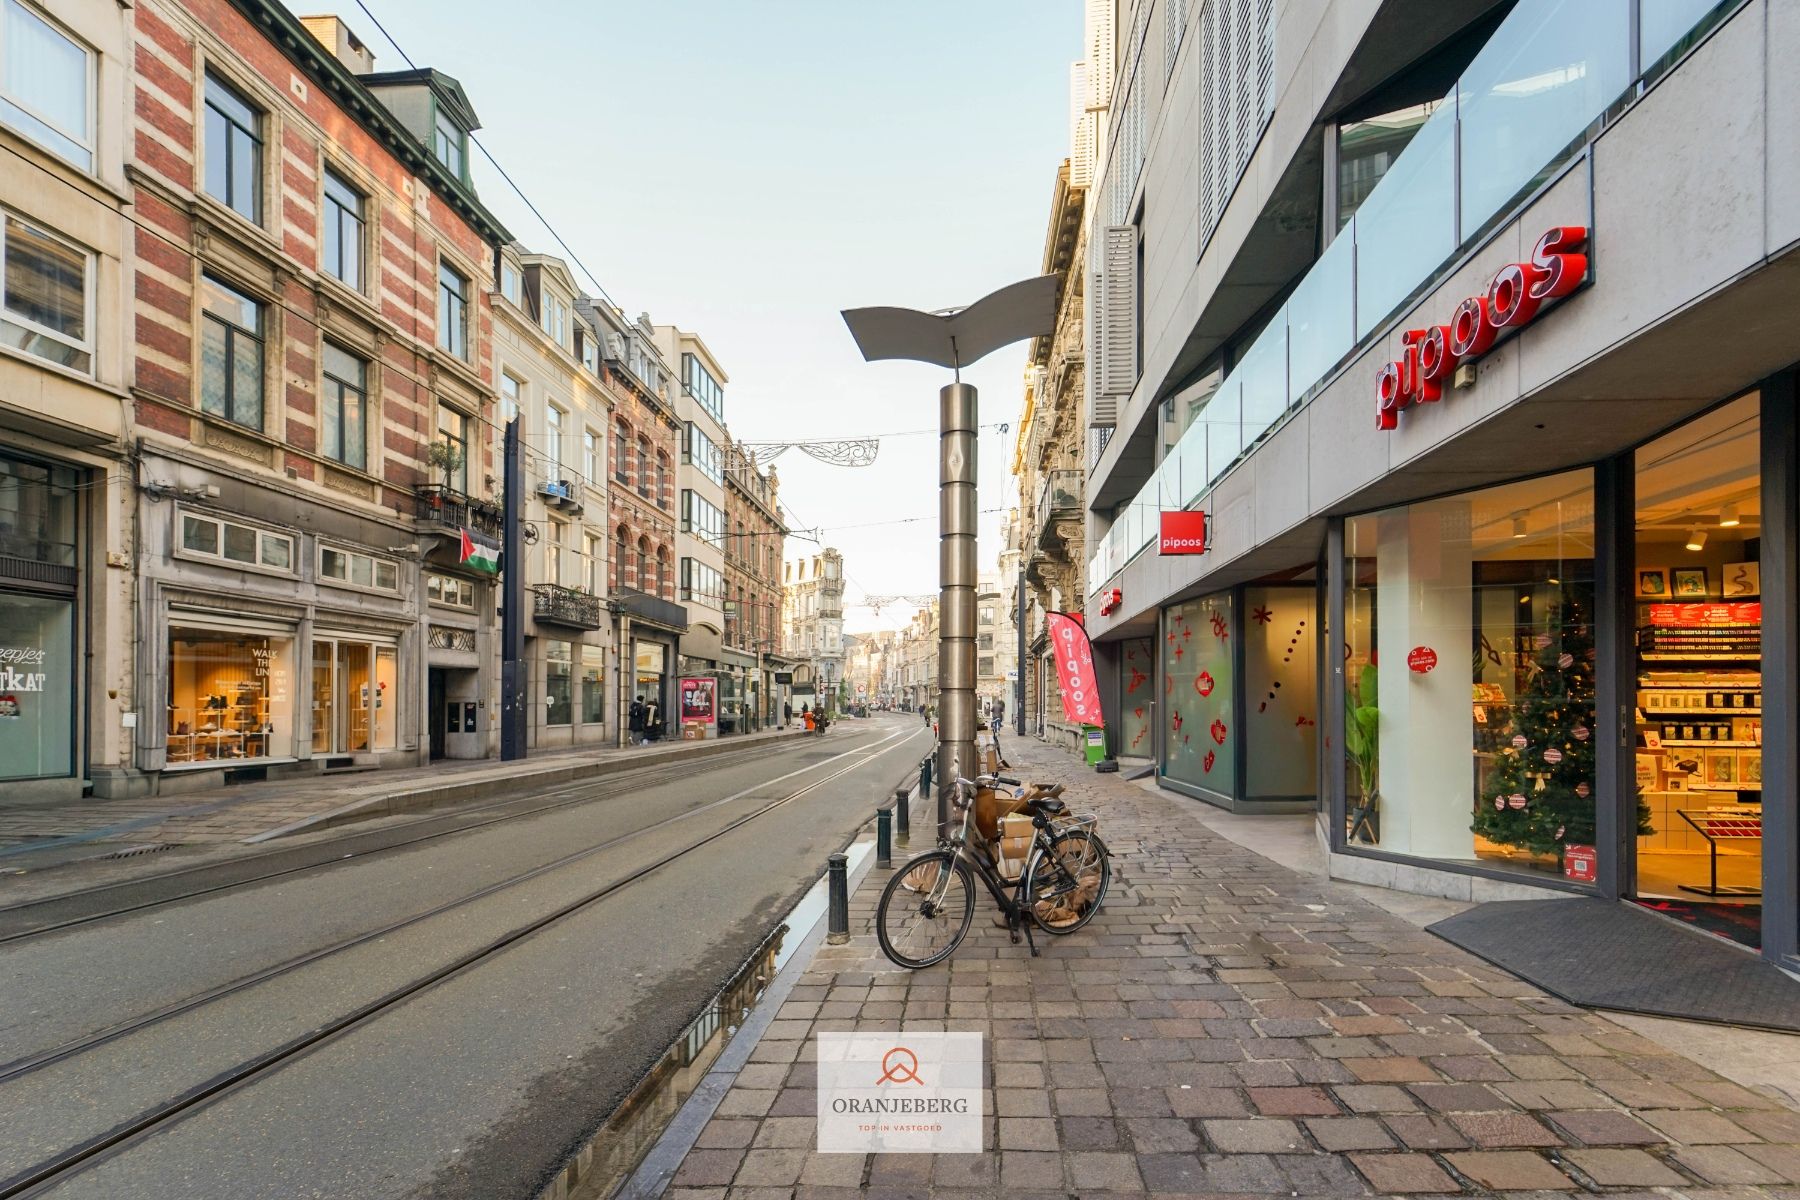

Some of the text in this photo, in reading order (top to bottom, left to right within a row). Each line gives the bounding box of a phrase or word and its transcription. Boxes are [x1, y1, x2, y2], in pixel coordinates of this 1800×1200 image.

[1375, 226, 1587, 431] pipoos
[1163, 536, 1201, 549] pipoos
[252, 648, 278, 658] WALK
[1061, 627, 1086, 716] pipoos
